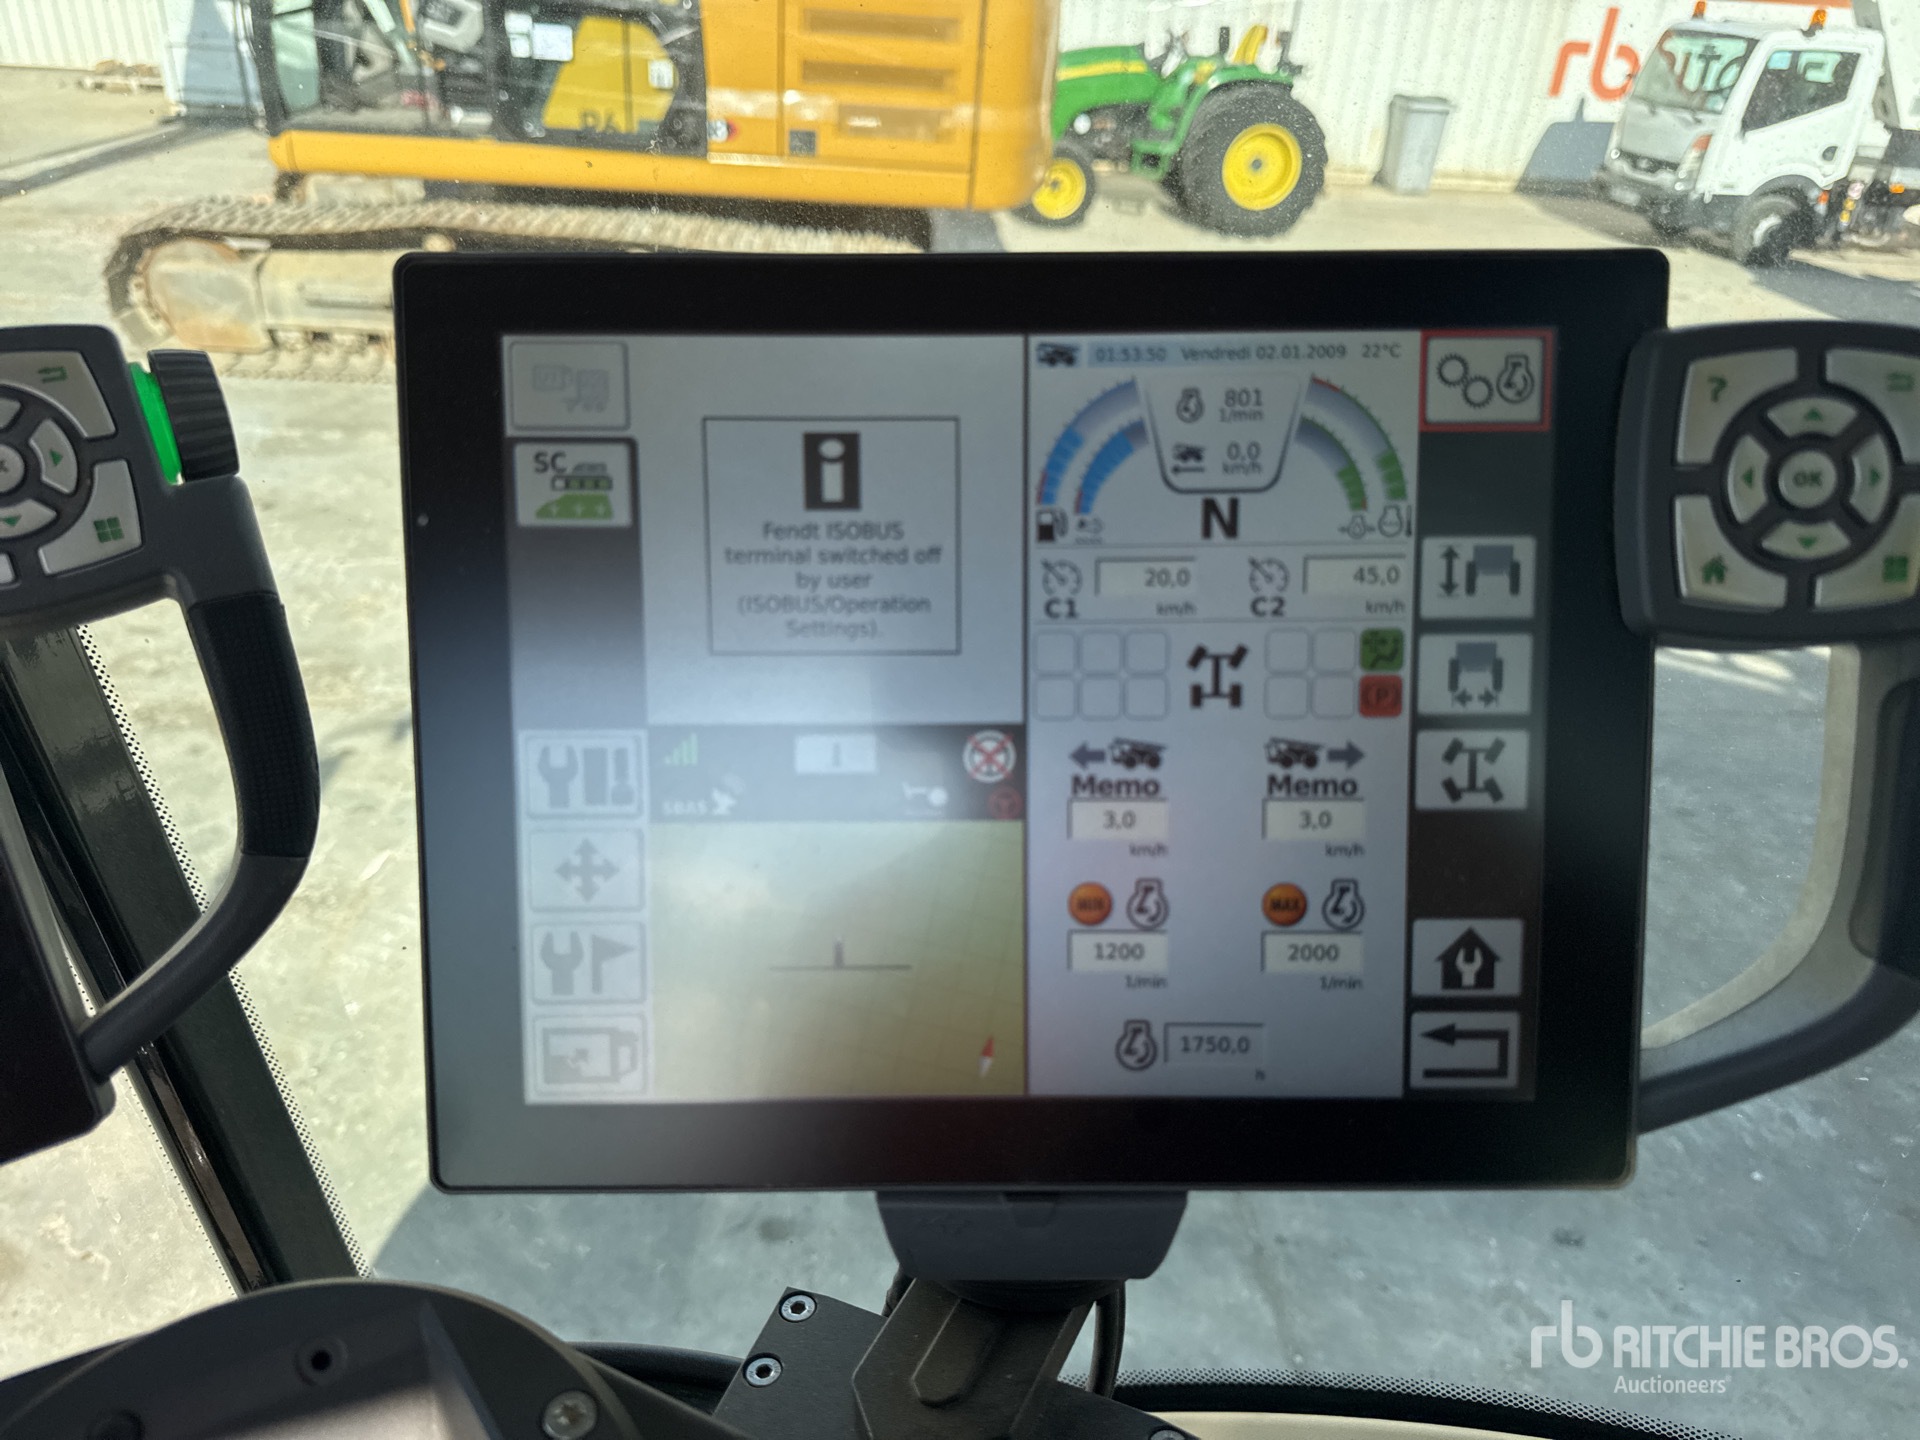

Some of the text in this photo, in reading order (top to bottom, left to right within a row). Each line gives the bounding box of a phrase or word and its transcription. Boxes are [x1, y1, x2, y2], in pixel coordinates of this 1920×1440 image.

[1181, 346, 1251, 360] Vendredi
[1256, 345, 1347, 360] 02.01.2009
[1361, 344, 1401, 359] 22°C
[1224, 388, 1263, 407] 801
[1219, 408, 1263, 423] 1/min
[533, 451, 568, 475] SC
[1222, 460, 1262, 475] km/h
[1792, 471, 1823, 488] OK
[1202, 498, 1239, 539] N
[762, 520, 905, 541] Fendt ISOBUS
[725, 544, 942, 565] terminal switched off
[796, 572, 872, 592] by user
[737, 595, 932, 616] (ISOBUS/Operation
[1044, 599, 1080, 619] C1
[1156, 601, 1197, 616] km/h
[1250, 597, 1286, 617] C2
[1365, 599, 1405, 614] km/h
[1071, 774, 1161, 797] Memo
[1266, 774, 1358, 797] Memo
[1129, 843, 1169, 857] km/h
[1325, 843, 1365, 857] km/h
[1094, 943, 1145, 961] 1200
[1287, 943, 1340, 962] 2000
[1124, 974, 1168, 989] 1/min
[1320, 974, 1363, 989] 1/min
